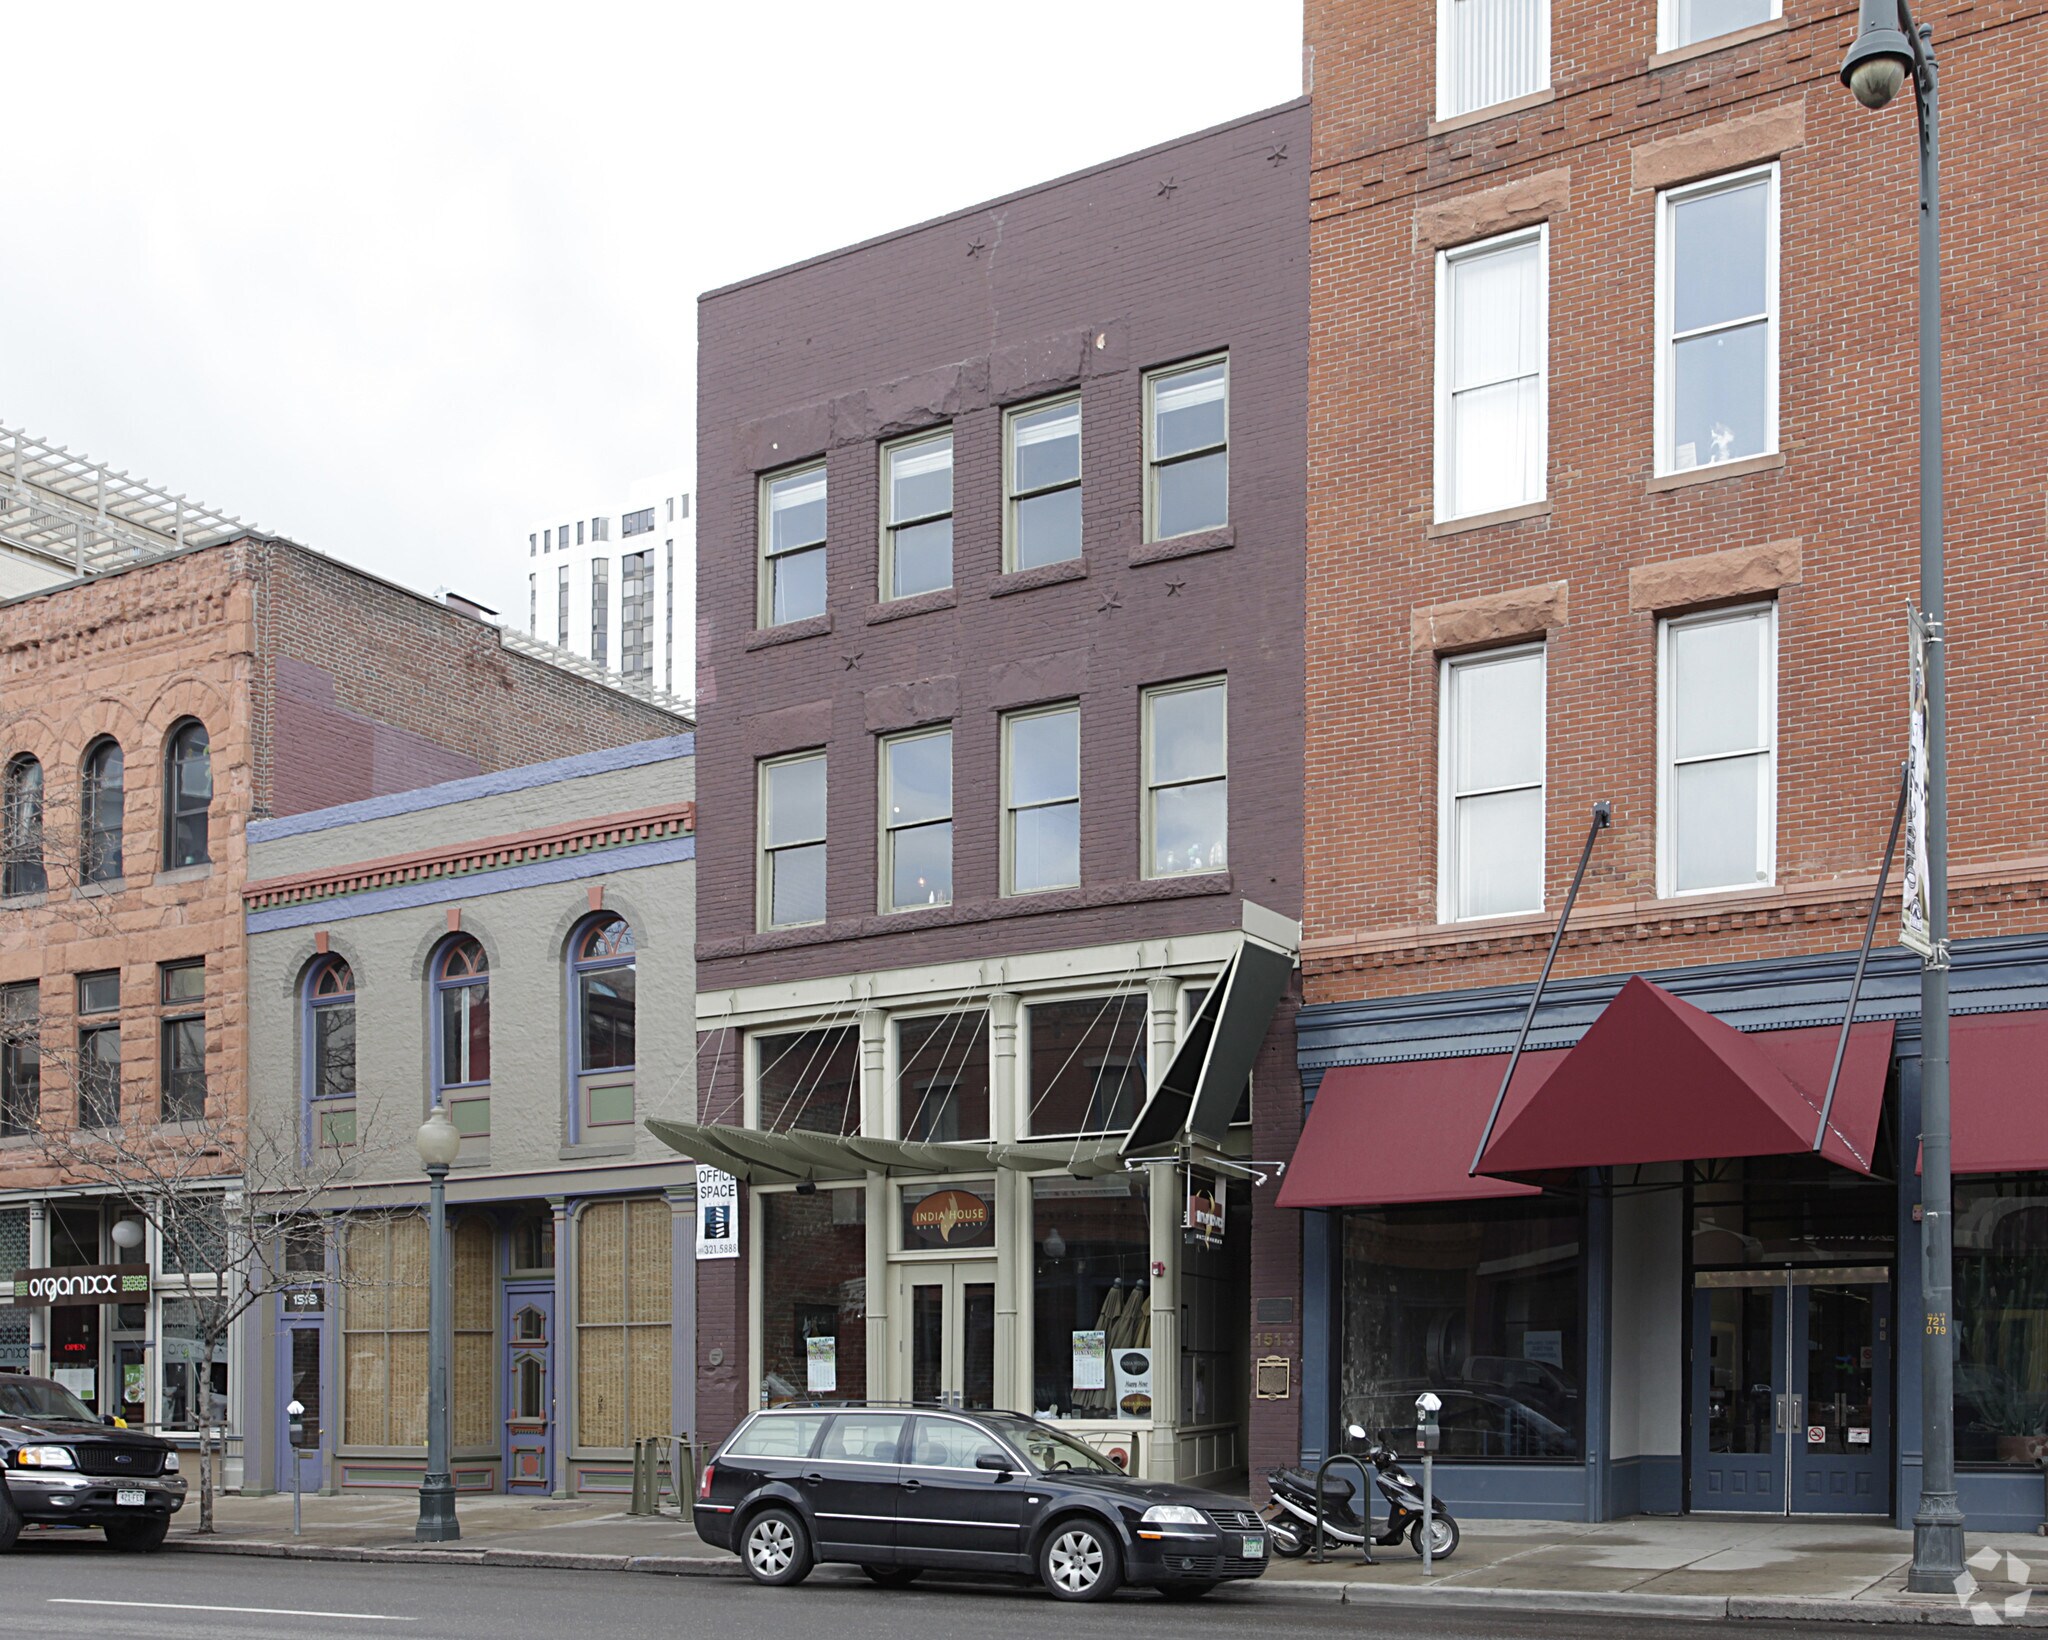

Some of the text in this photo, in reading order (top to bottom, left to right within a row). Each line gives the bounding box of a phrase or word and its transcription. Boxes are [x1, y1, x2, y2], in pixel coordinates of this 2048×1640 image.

[701, 1184, 735, 1199] SPACE
[916, 1208, 984, 1222] INDIA HOUSE
[704, 1243, 737, 1255] 321.5888
[29, 1274, 117, 1302] organixx
[1927, 1316, 1945, 1326] 721
[1926, 1325, 1947, 1335] 079
[64, 1343, 86, 1351] OPEN
